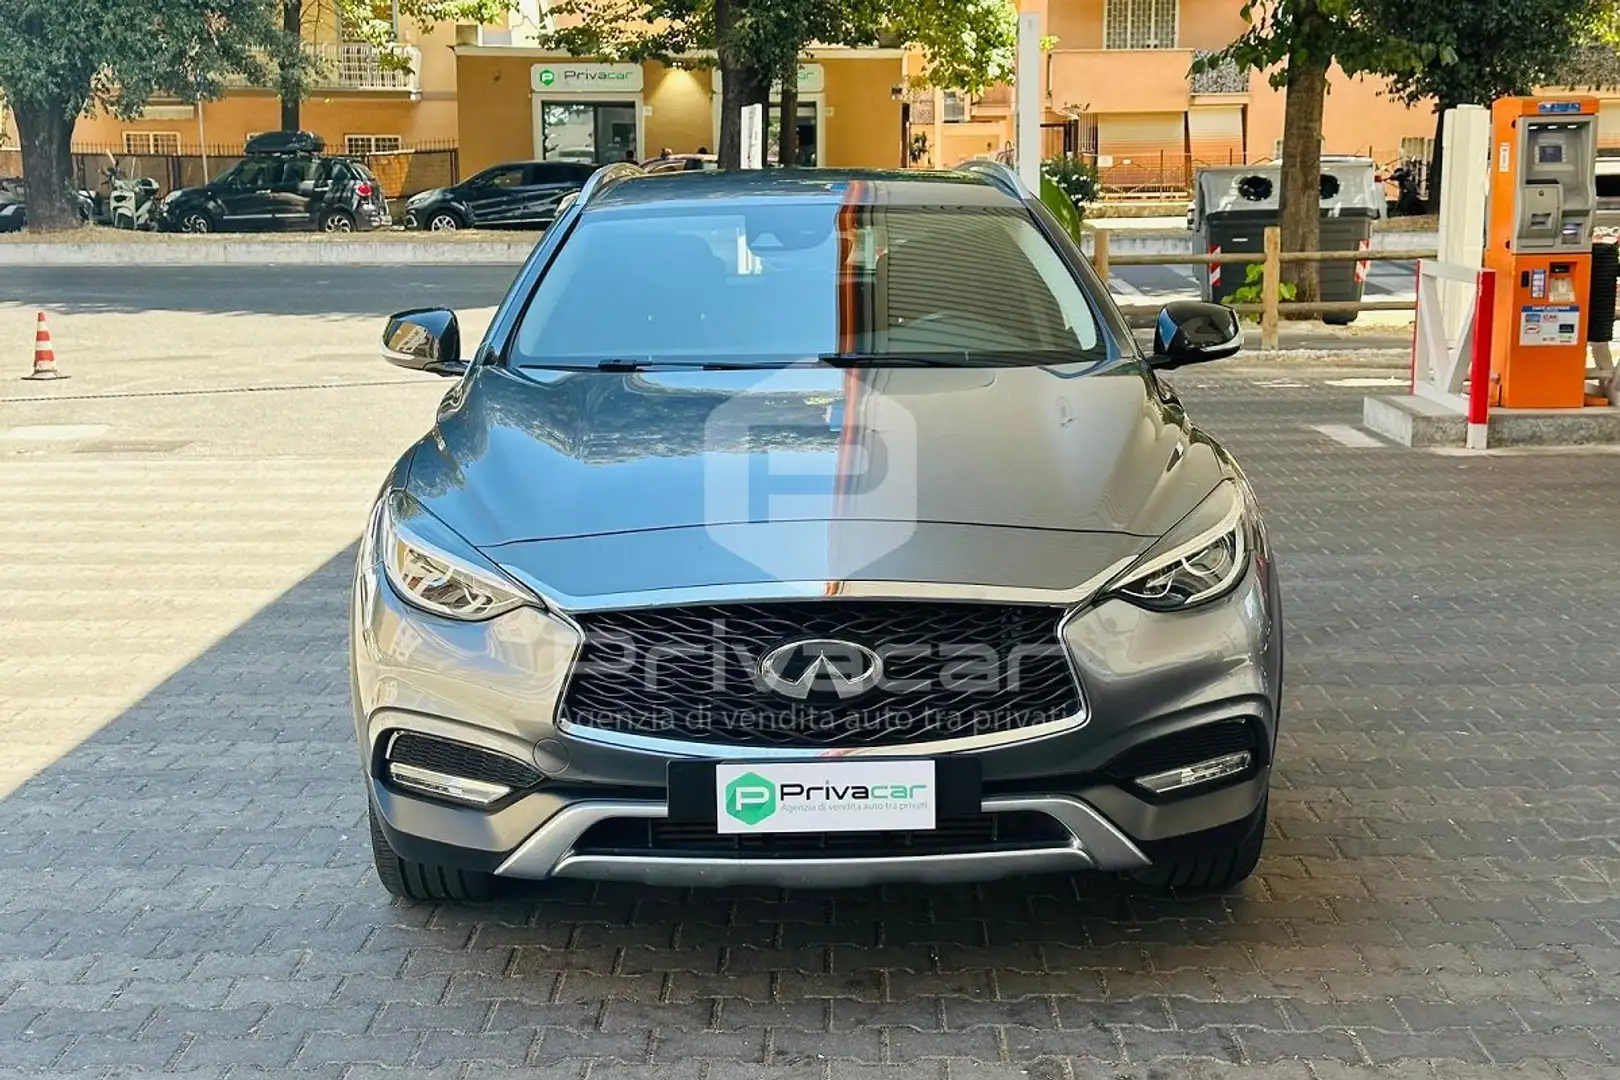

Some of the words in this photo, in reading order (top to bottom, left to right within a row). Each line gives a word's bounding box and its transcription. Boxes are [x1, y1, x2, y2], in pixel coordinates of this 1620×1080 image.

[564, 68, 633, 80] Privacar
[780, 780, 927, 801] Privacar
[780, 803, 816, 814] Agenzia
[818, 803, 827, 812] di
[829, 802, 861, 812] vendita
[863, 802, 884, 811] auto
[885, 801, 897, 810] tra
[899, 801, 928, 811] privati
